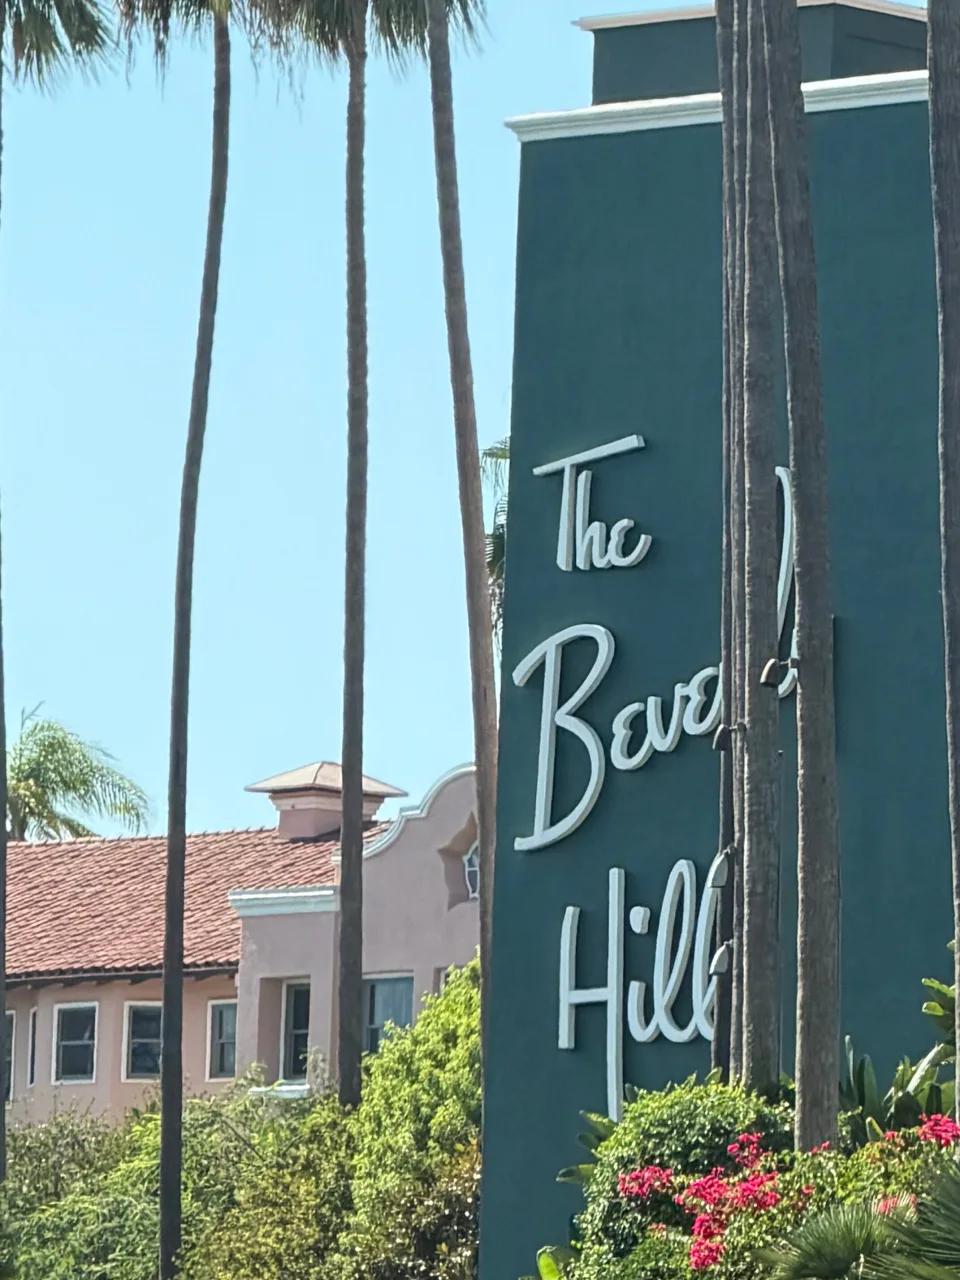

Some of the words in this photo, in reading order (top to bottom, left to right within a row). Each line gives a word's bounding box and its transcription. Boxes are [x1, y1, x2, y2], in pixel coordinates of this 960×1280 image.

[532, 434, 652, 572] The
[512, 466, 799, 851] Beve
[557, 852, 722, 1123] Hill
